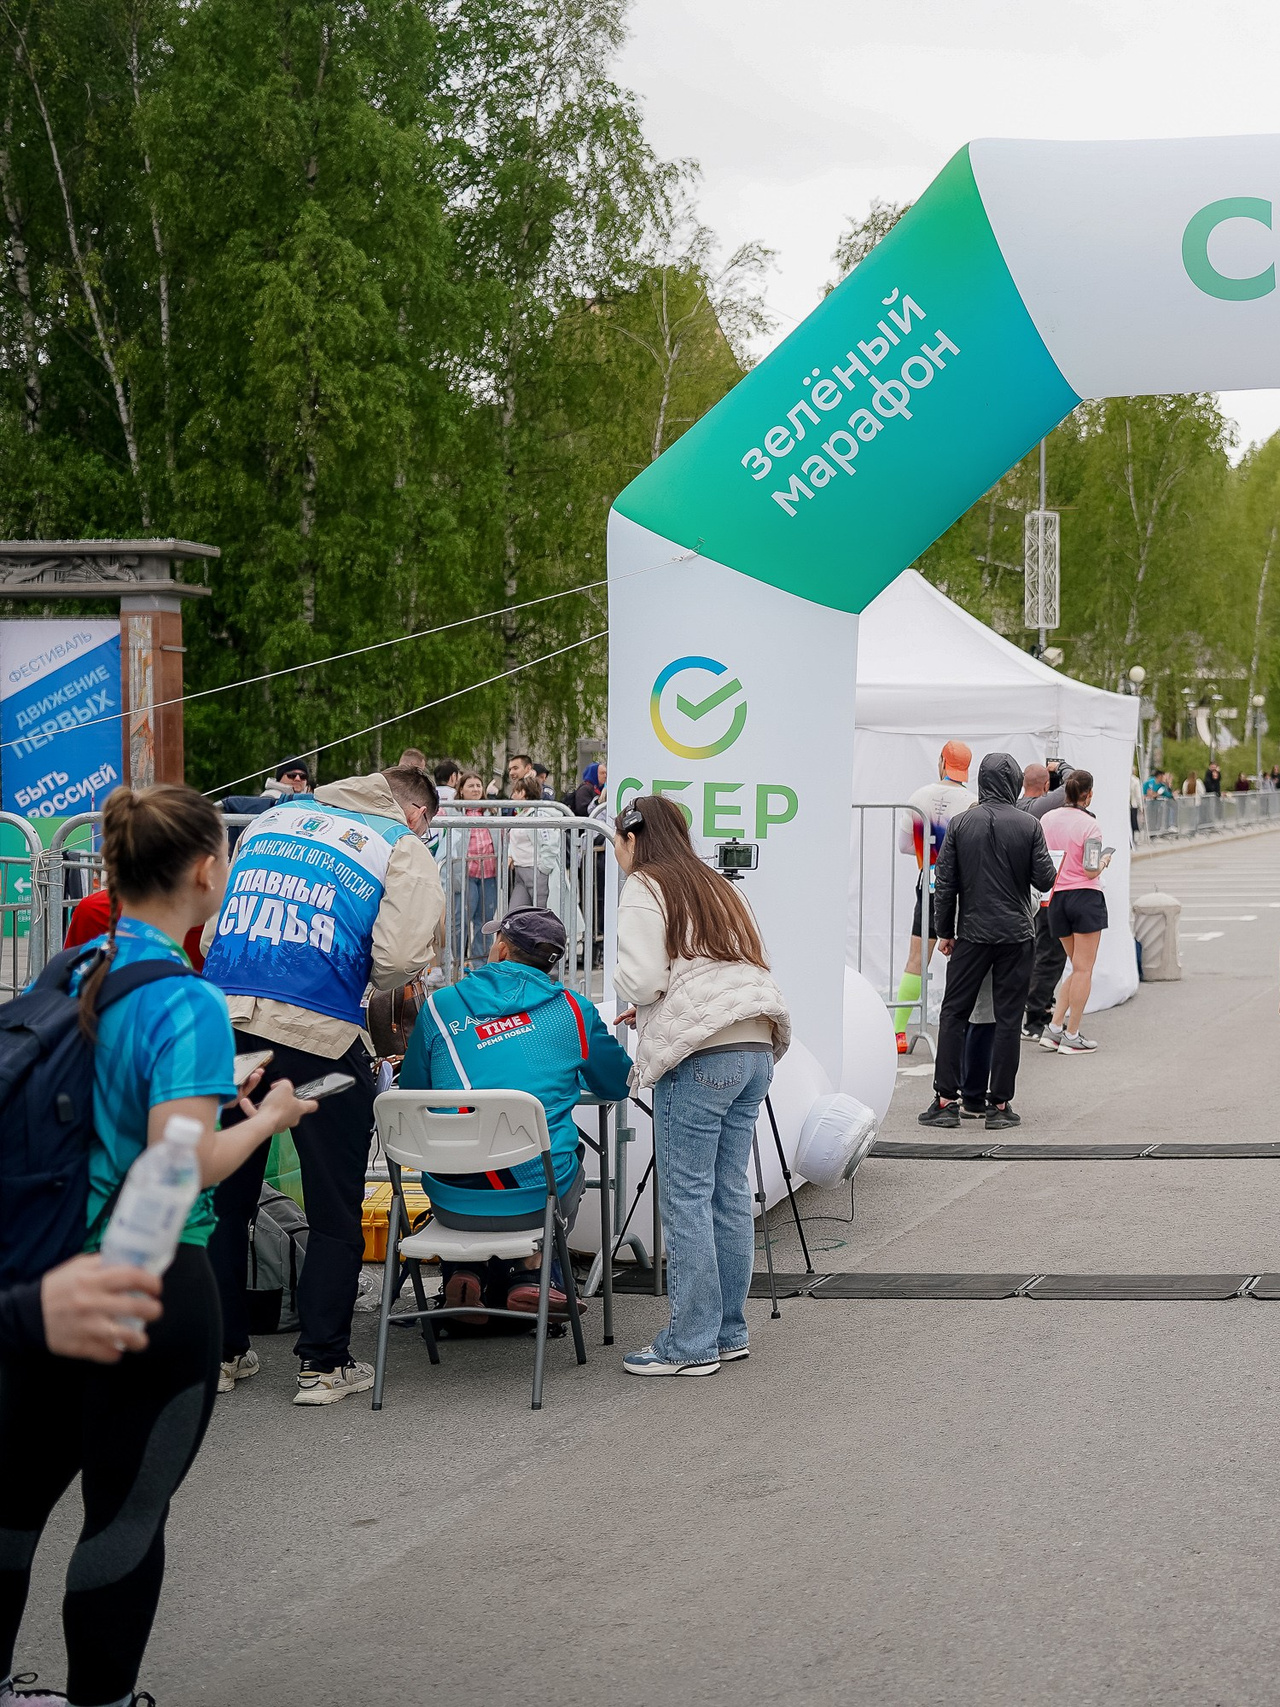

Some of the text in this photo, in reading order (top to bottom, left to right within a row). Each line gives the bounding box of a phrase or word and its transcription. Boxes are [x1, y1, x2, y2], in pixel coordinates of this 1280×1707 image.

[740, 286, 927, 481] зелёный
[770, 328, 962, 518] марафон
[8, 631, 93, 684] ФЕСТИВАЛЬ
[9, 687, 116, 760] ПЕРВЫХ
[14, 664, 111, 731] ДВИЖЕНИЕ
[14, 770, 70, 808] БЫТЬ
[304, 847, 336, 873] ЮГРА
[232, 868, 337, 912] ГЛАВНЫЙ
[218, 894, 336, 954] СУДЬЯ
[476, 1035, 504, 1050] ВРЕМЯ
[482, 1015, 524, 1036] TIME
